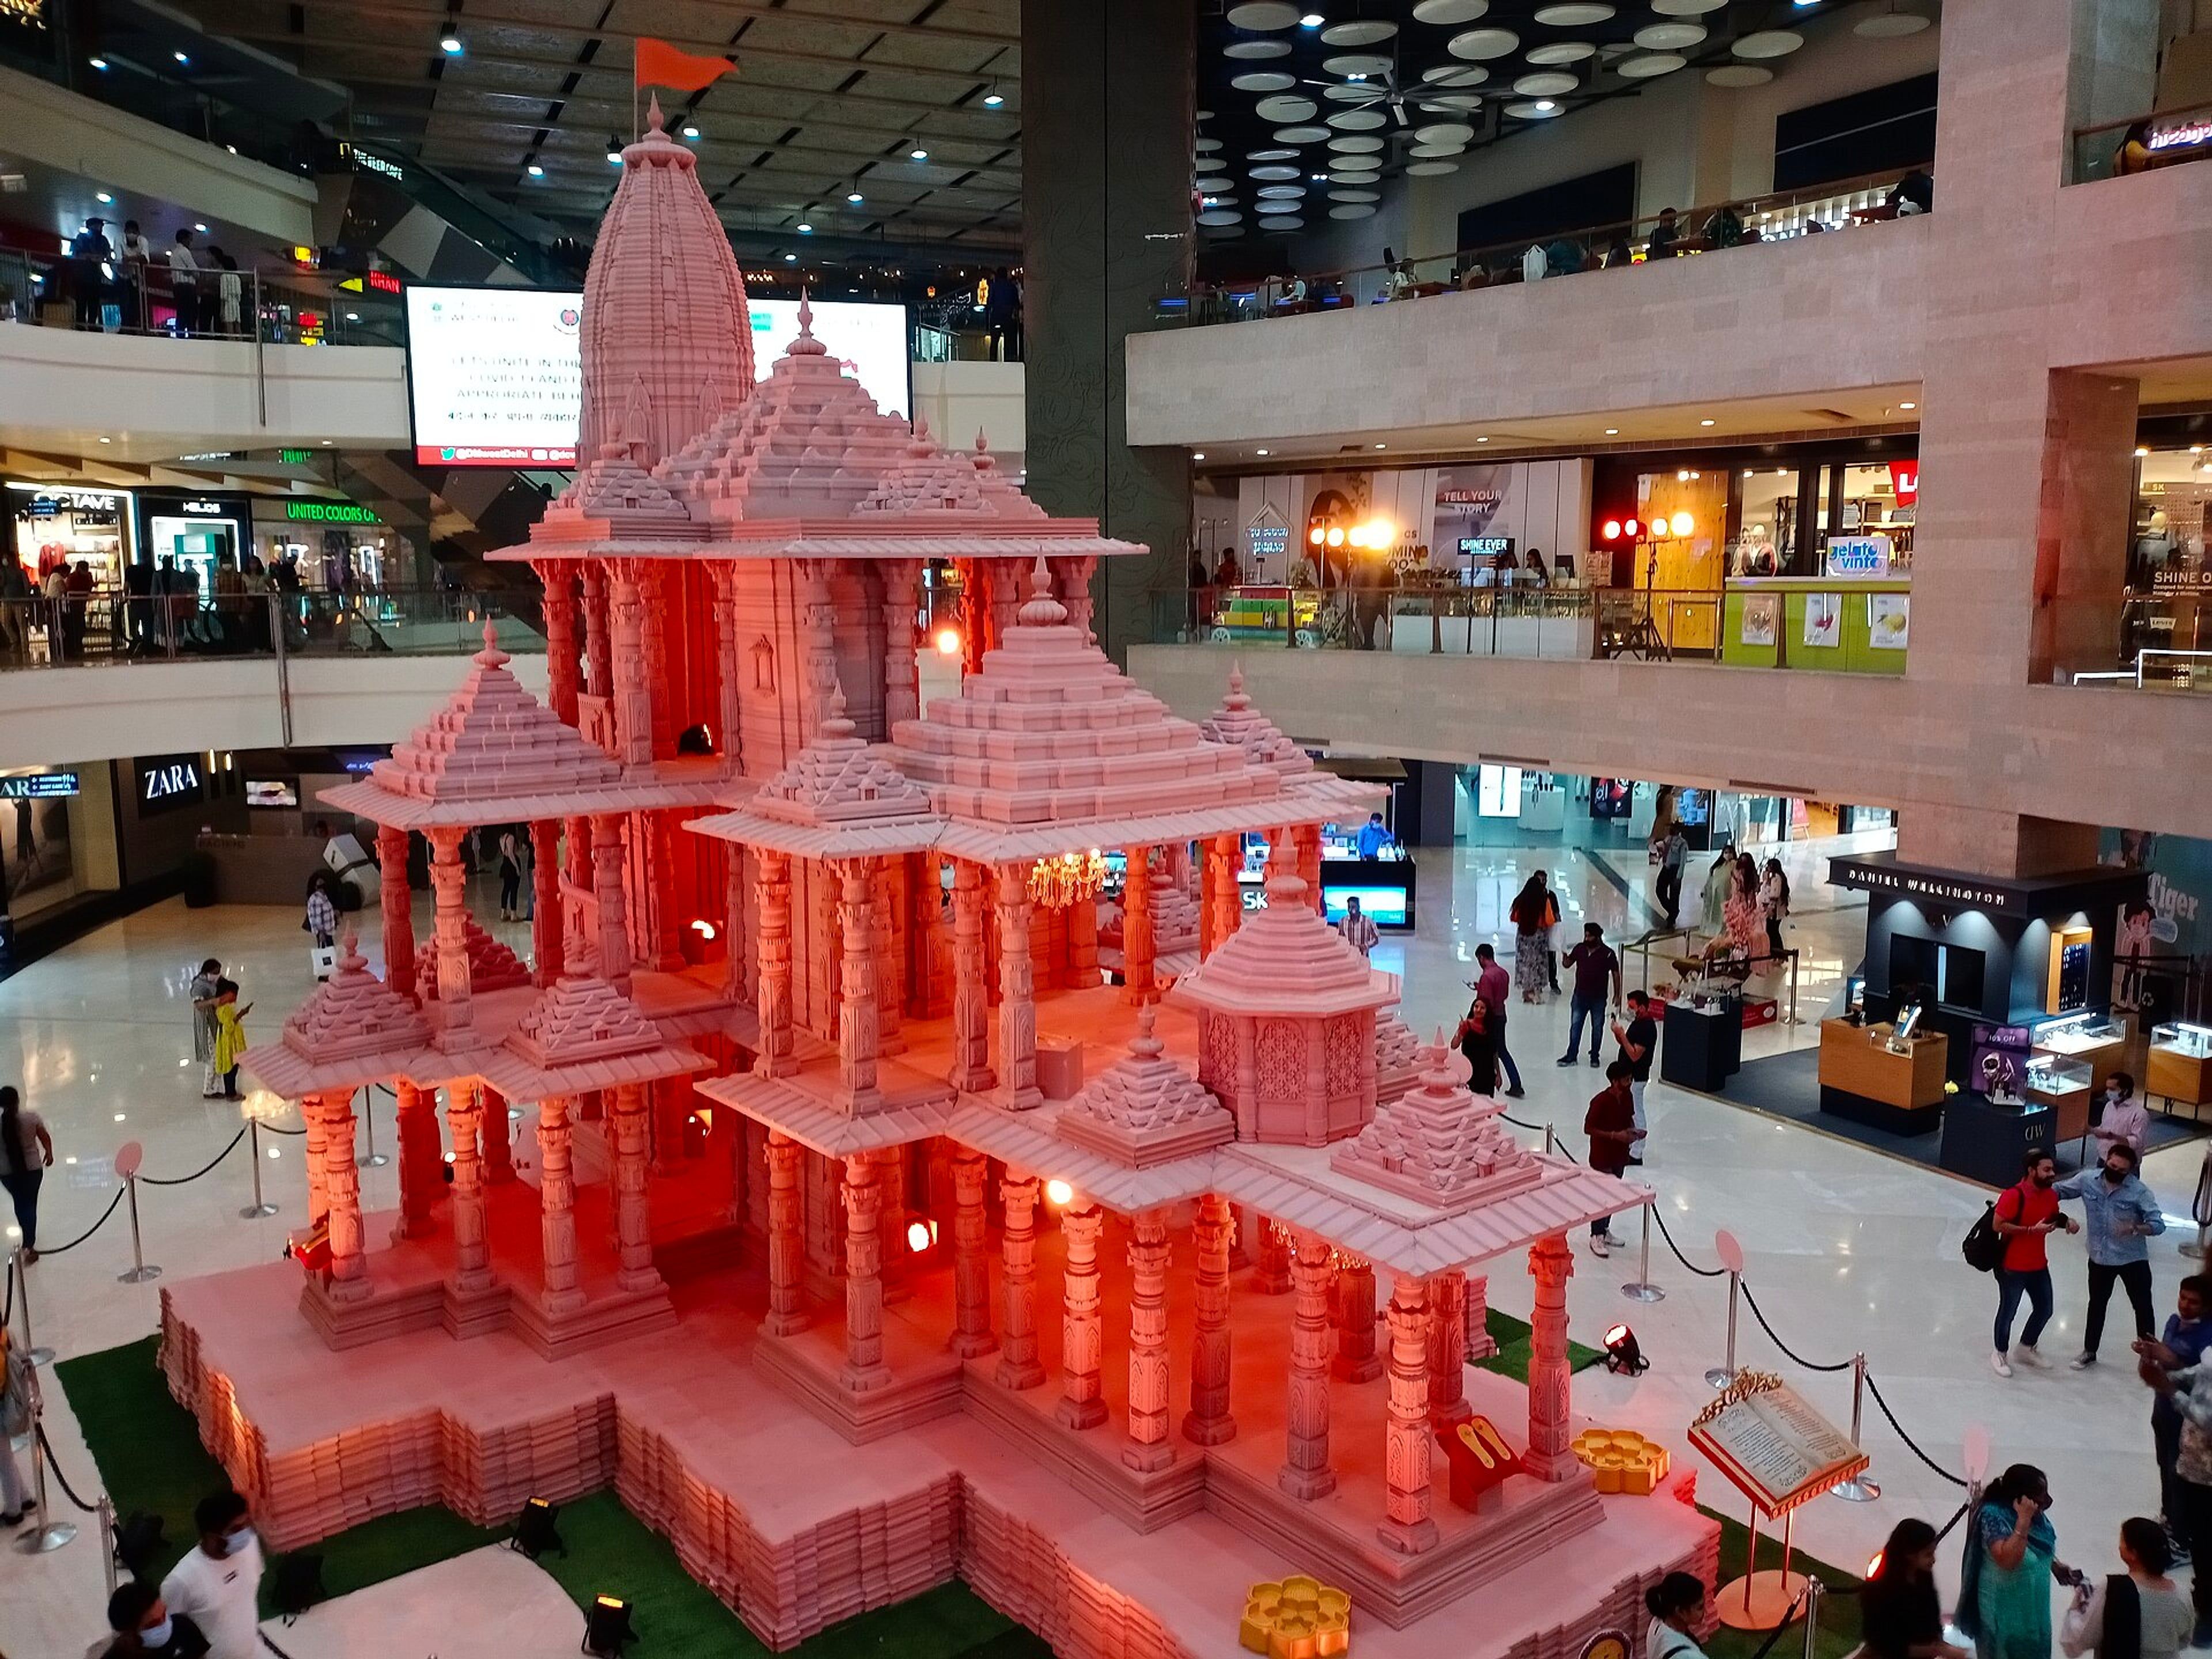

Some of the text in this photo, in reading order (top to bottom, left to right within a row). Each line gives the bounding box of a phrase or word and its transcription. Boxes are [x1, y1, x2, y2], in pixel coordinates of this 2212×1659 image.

[370, 271, 400, 293] KHAN
[1444, 490, 1502, 502] TELL YOUR
[183, 502, 221, 514] HELIOS
[288, 502, 324, 520] UNITED
[325, 505, 362, 522] COLORS
[1455, 502, 1491, 514] STORY
[1829, 541, 1879, 560] gelato
[1842, 555, 1884, 569] vinto
[2154, 571, 2198, 584] SHINE
[145, 763, 198, 799] ZARA
[1849, 869, 2005, 906] DANIEL WELLINGTON
[2147, 872, 2199, 921] Tiger
